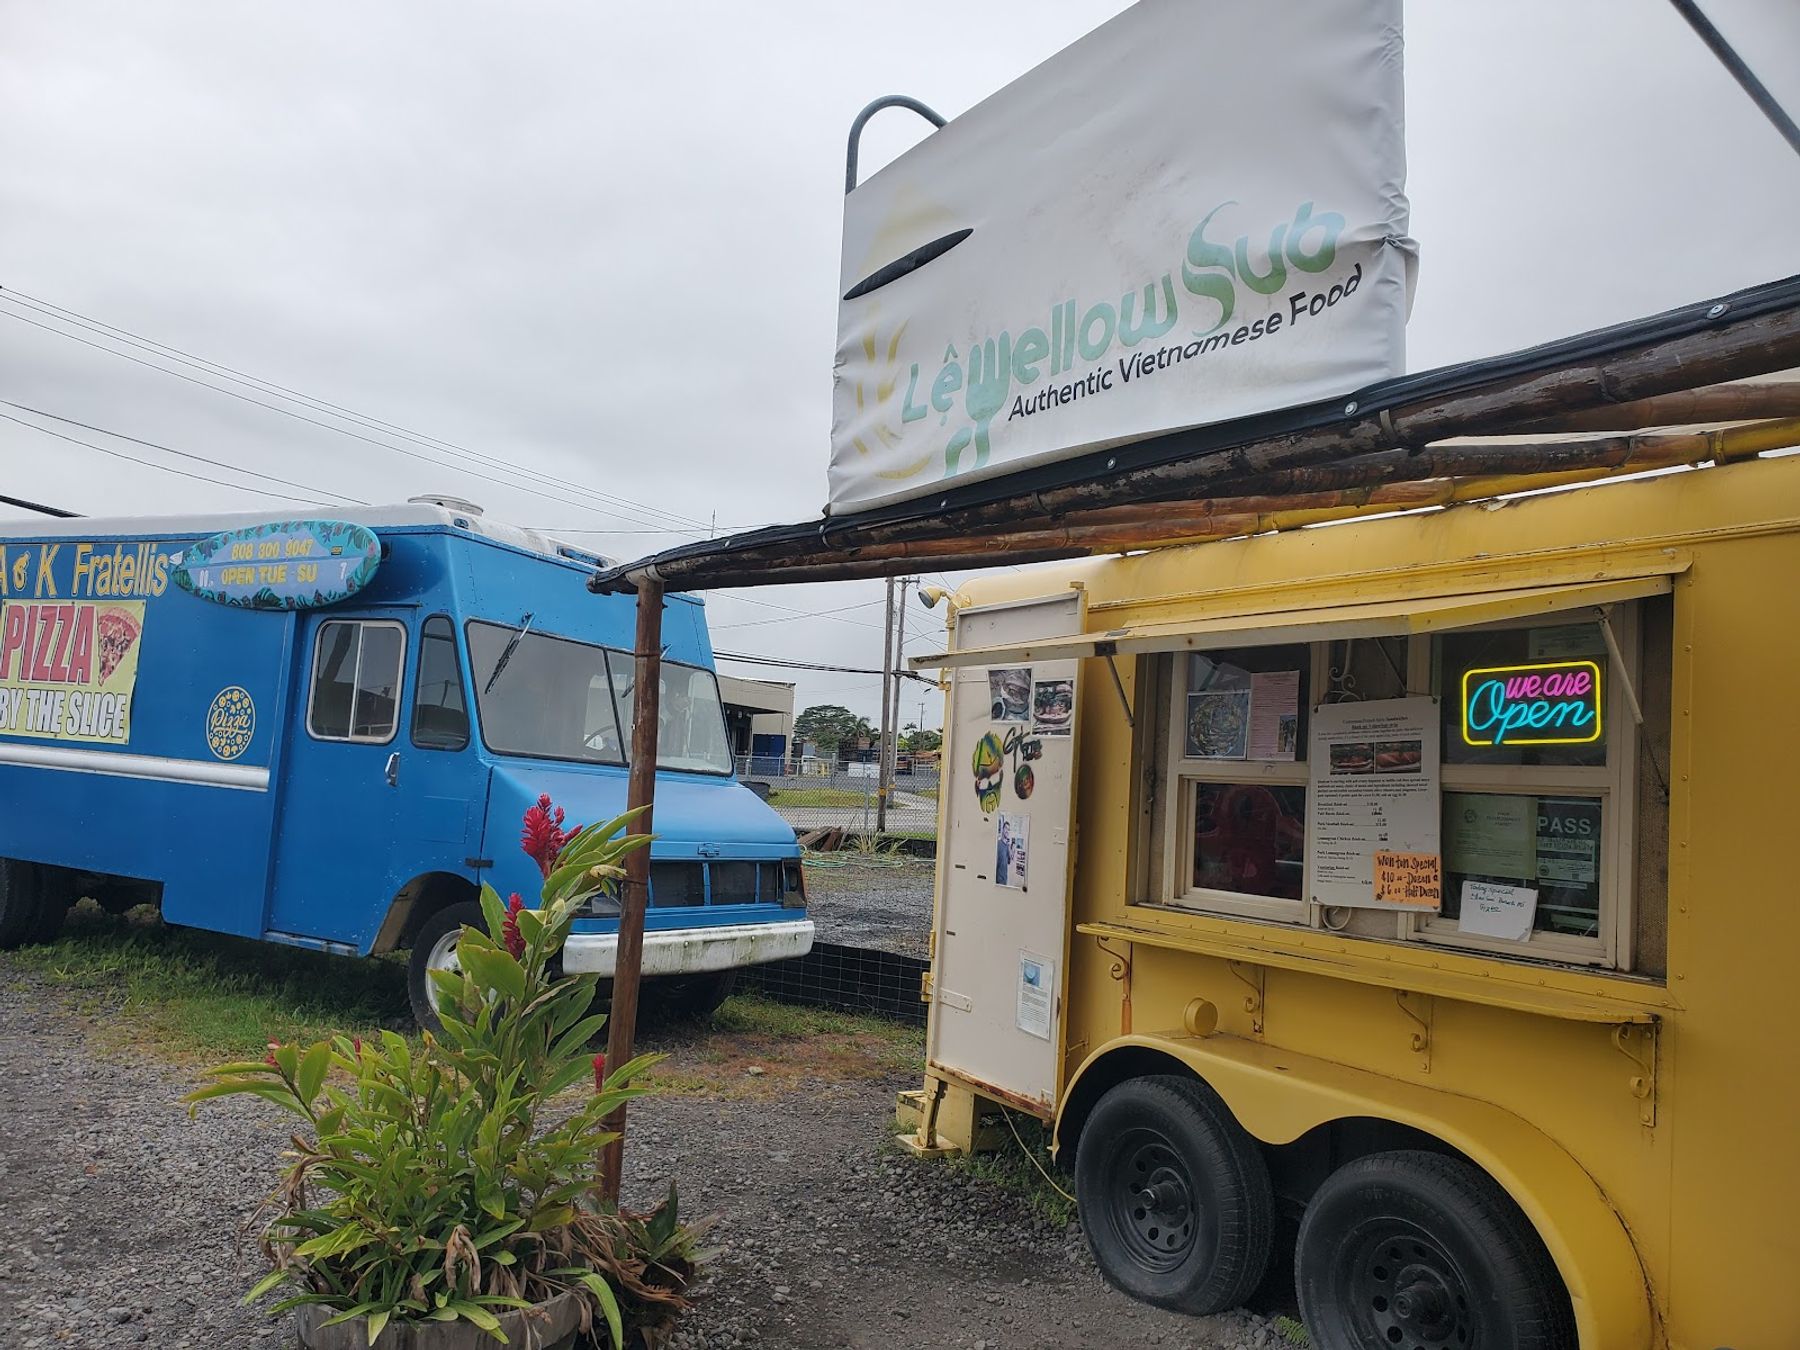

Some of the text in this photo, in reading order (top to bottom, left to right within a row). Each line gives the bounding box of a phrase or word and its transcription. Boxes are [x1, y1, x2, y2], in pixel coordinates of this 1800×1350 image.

[1182, 201, 1345, 337] Sub
[1008, 262, 1363, 421] Authentic Vietnamese Food
[34, 544, 61, 598] K
[71, 544, 169, 597] Fratellis
[221, 567, 255, 586] OPEN
[258, 565, 289, 584] TUE
[0, 604, 96, 685] PIZZA
[1504, 670, 1593, 700] we are
[0, 687, 128, 739] BY THE SLICE
[211, 708, 251, 738] Pizza
[1468, 679, 1595, 745] Open
[1537, 815, 1592, 835] PASS
